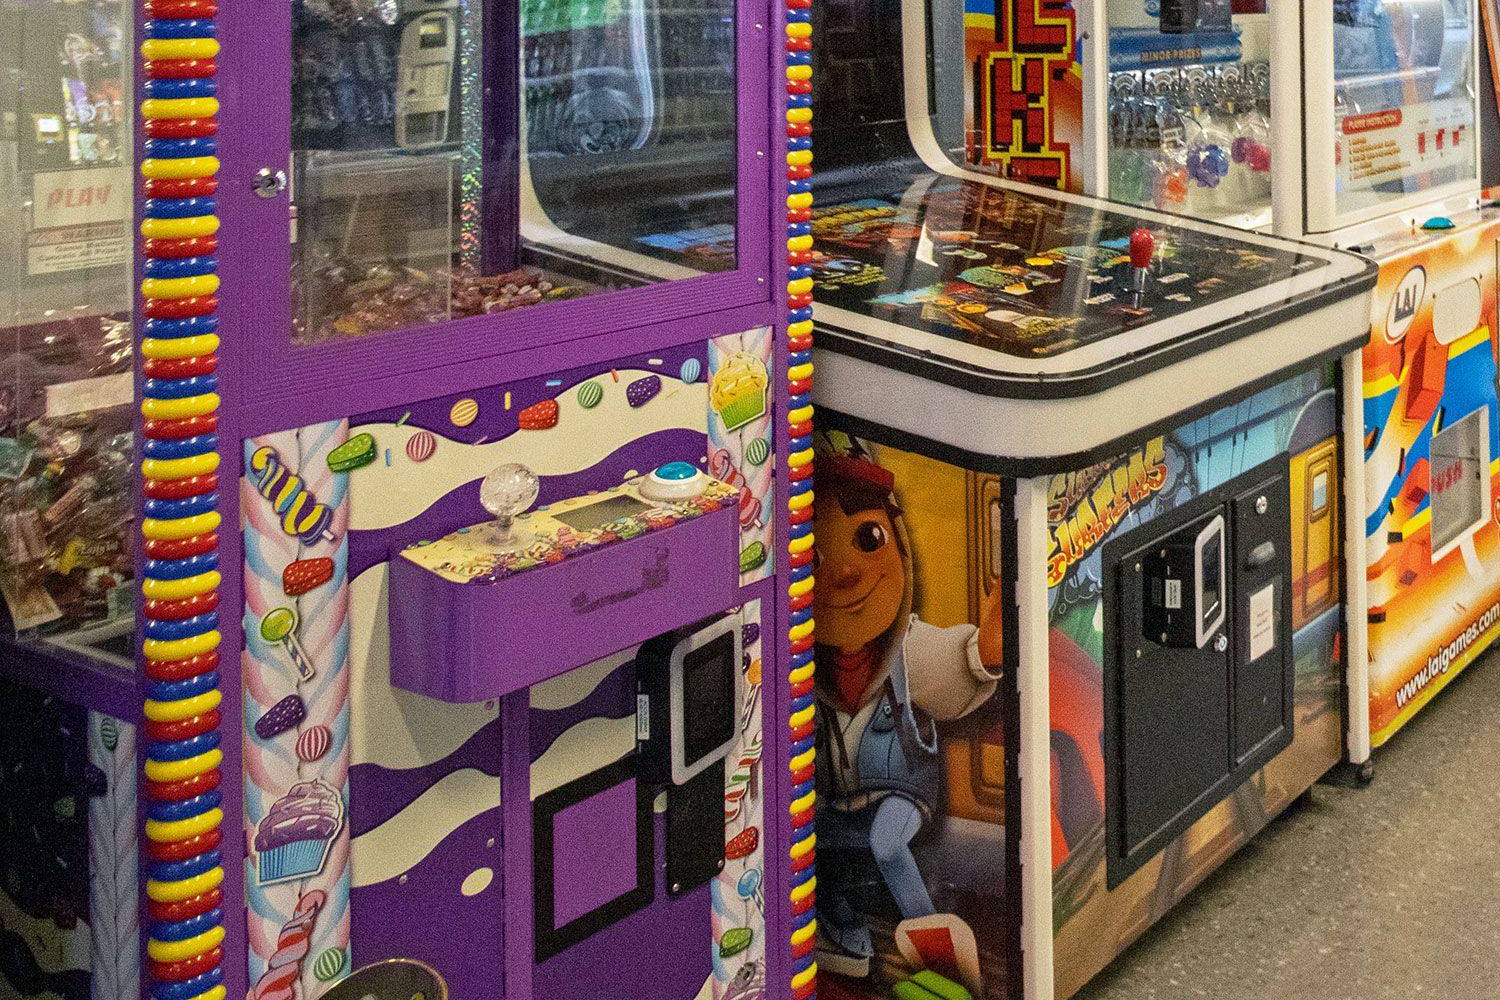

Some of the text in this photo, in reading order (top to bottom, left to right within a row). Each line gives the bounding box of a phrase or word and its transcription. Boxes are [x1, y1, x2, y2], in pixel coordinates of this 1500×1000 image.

[1140, 48, 1201, 63] MINOR PRIZES
[48, 183, 112, 211] PLAY
[1394, 284, 1417, 324] LAI
[1395, 602, 1500, 709] www.laigames.com
